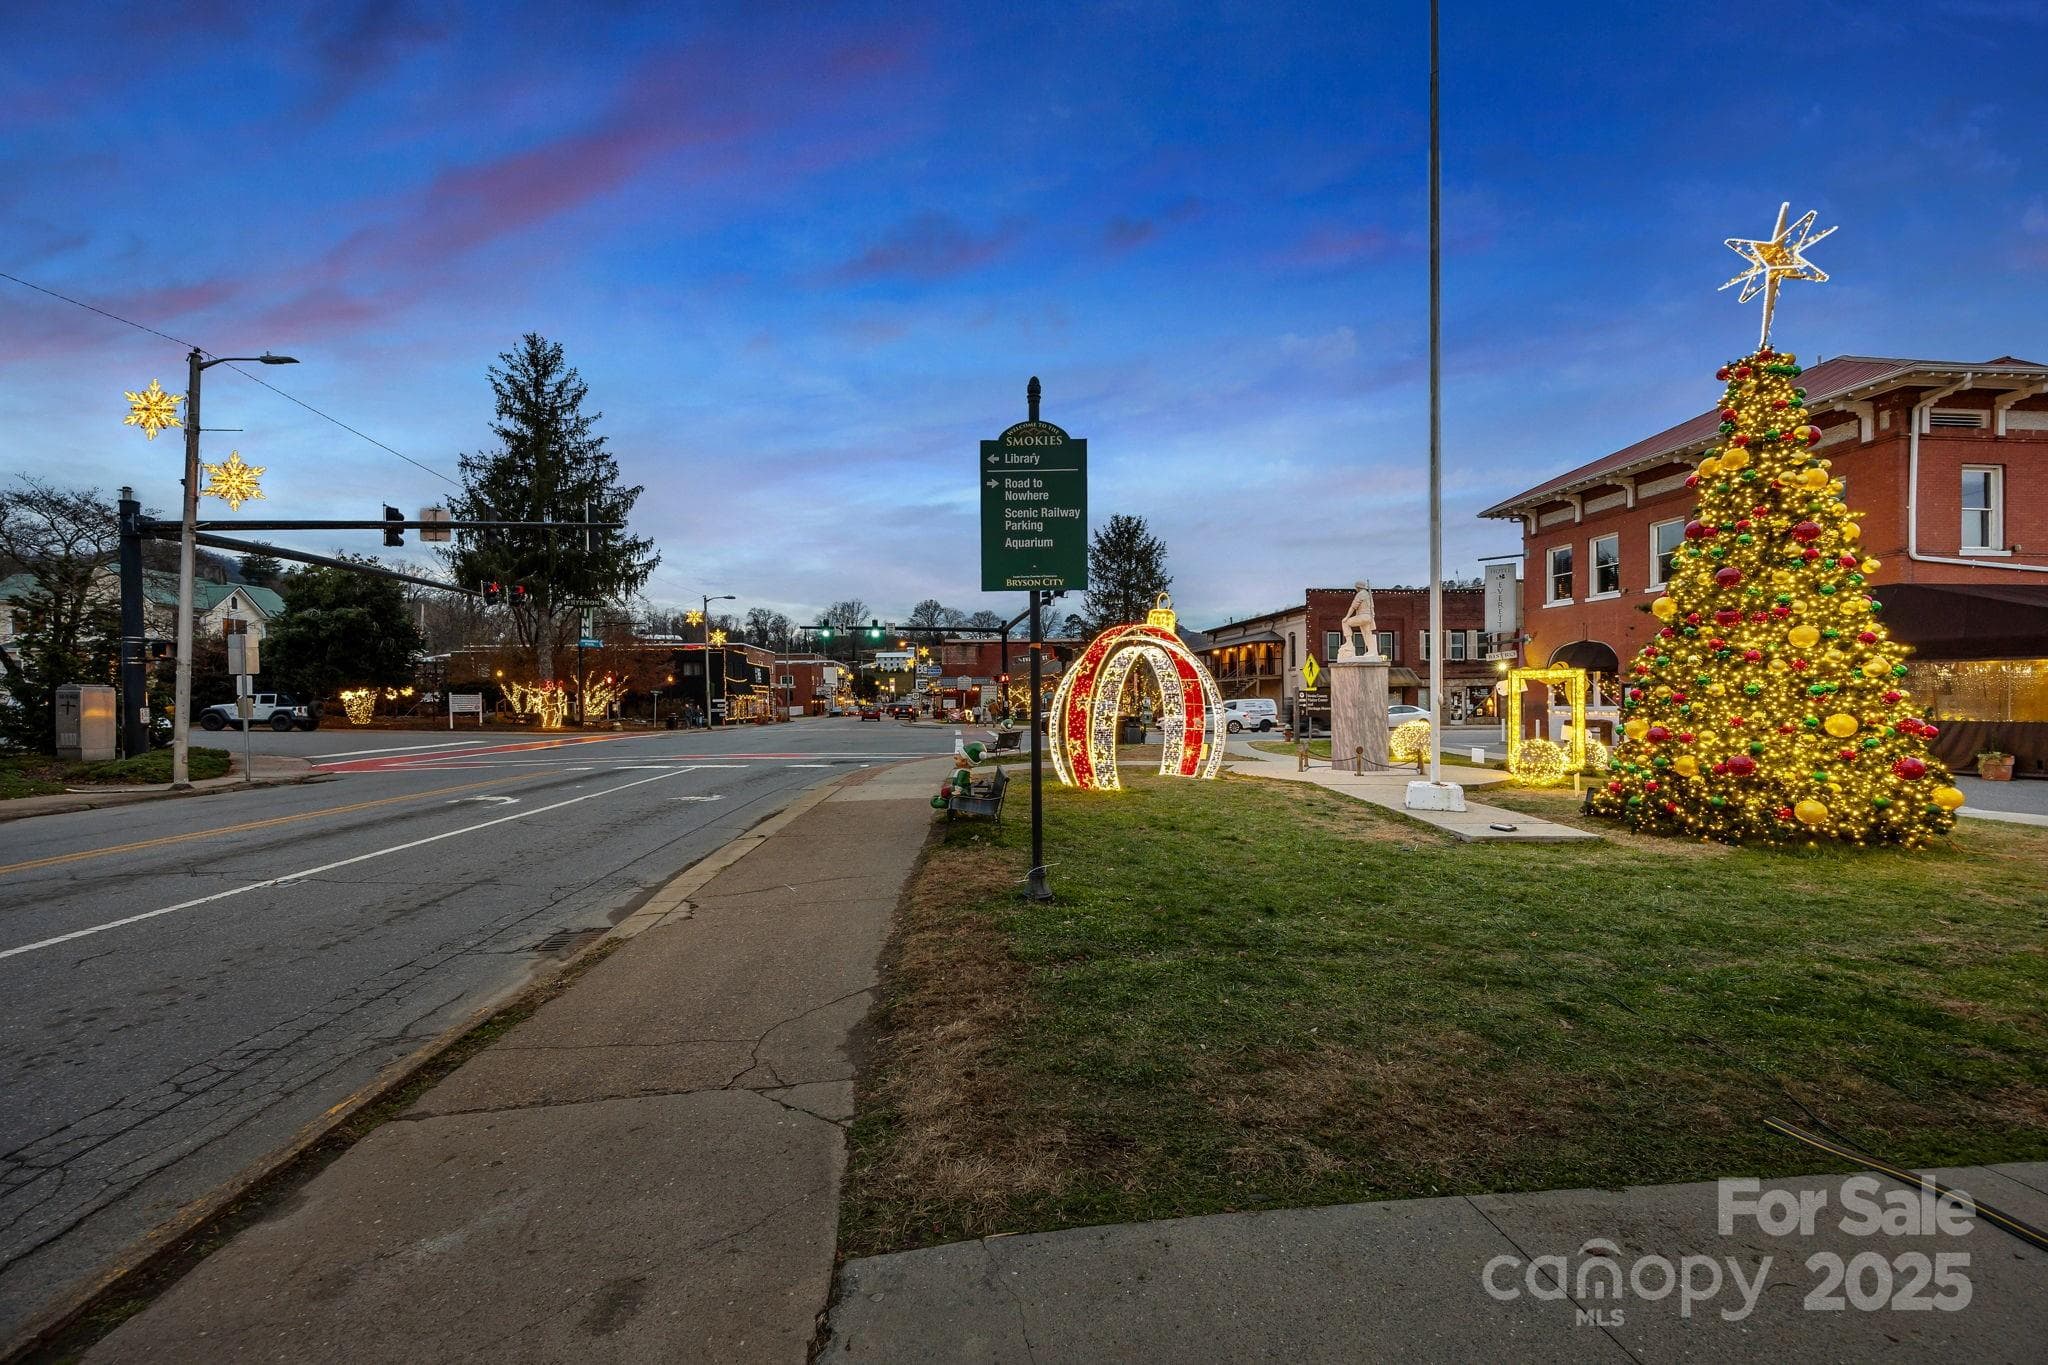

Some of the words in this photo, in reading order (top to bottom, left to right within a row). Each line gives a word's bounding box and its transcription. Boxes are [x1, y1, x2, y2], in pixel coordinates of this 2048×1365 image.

[1007, 422, 1037, 436] WELCOME
[1048, 425, 1060, 435] THE
[1006, 435, 1063, 447] SMOKIES
[1004, 453, 1040, 466] Library
[1004, 478, 1030, 488] Road
[1033, 478, 1043, 488] to
[1004, 490, 1049, 501] Nowhere
[1004, 508, 1038, 518] Scenic
[1041, 507, 1081, 519] Railway
[1005, 520, 1044, 532] Parking
[1004, 537, 1054, 549] Aquarium
[1006, 579, 1041, 587] BRYSON
[1042, 578, 1065, 586] CITY
[581, 607, 589, 638] INN
[1488, 651, 1516, 660] BISTRO
